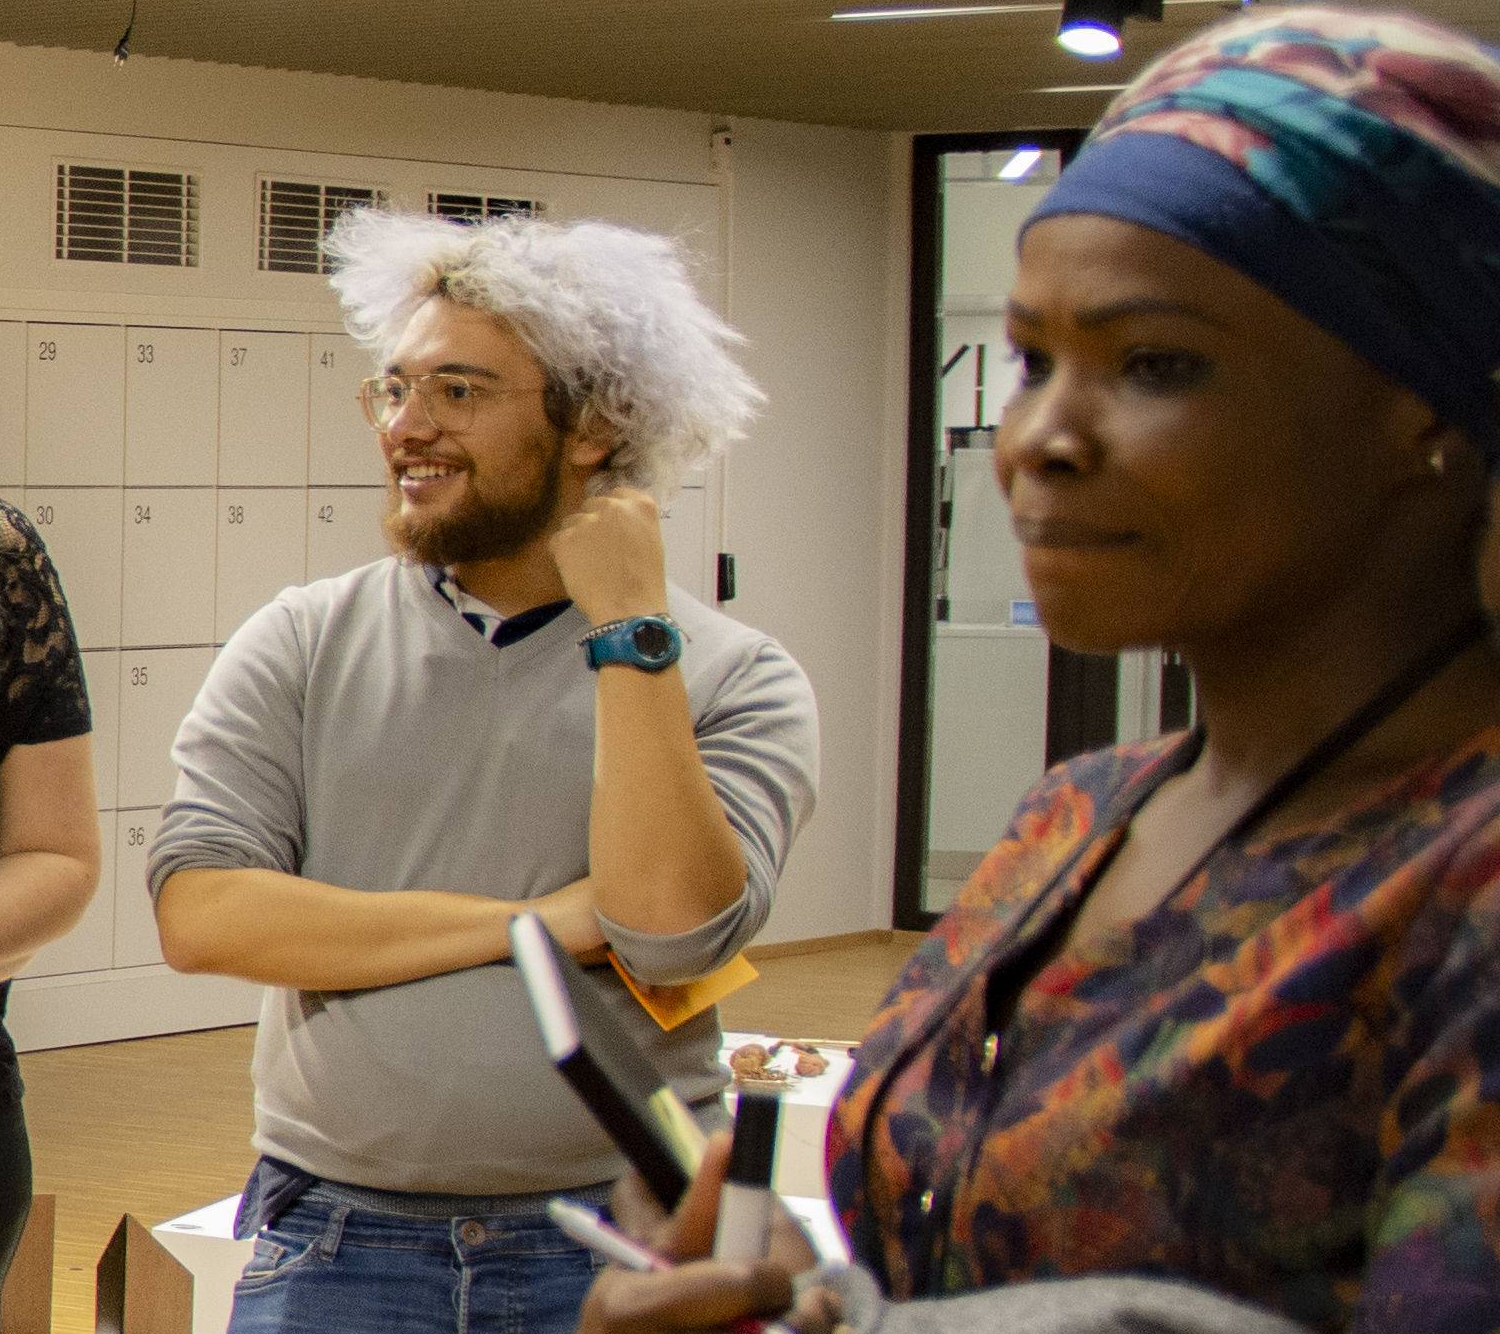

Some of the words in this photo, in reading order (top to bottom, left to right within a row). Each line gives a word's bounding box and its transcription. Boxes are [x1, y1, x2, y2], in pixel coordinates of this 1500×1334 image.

[38, 341, 57, 361] 29
[137, 344, 154, 364] 33
[230, 347, 247, 367] 37
[320, 351, 335, 369] 41
[36, 505, 54, 525] 30
[134, 504, 151, 524] 34
[228, 505, 244, 524] 38
[317, 504, 334, 524] 42
[131, 667, 148, 686] 35
[127, 826, 145, 846] 36
